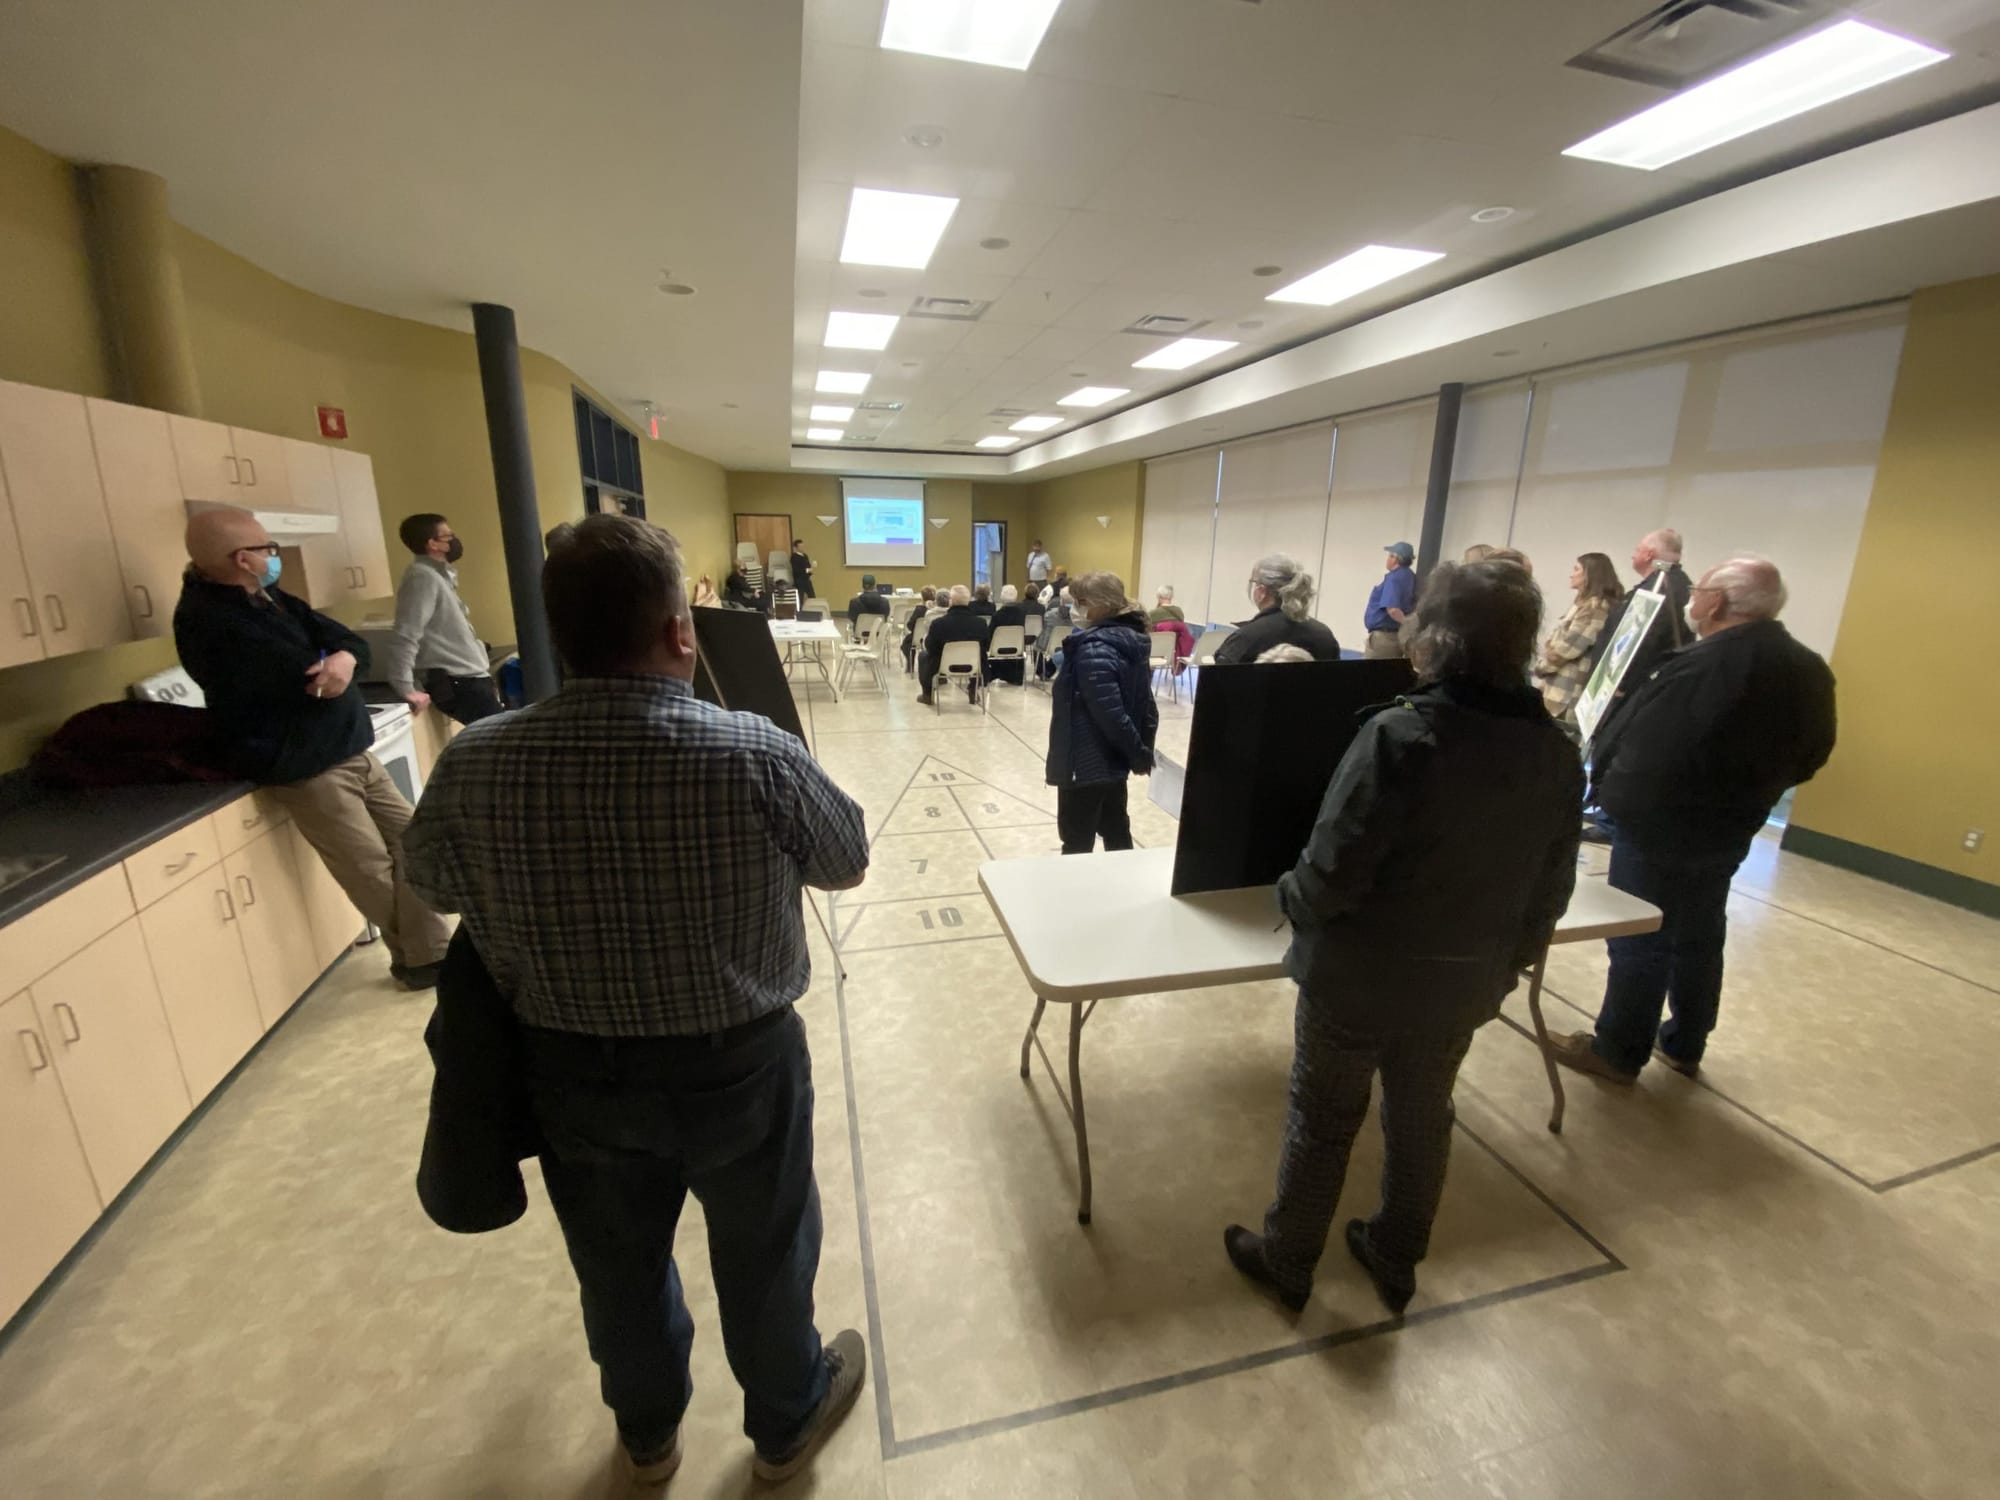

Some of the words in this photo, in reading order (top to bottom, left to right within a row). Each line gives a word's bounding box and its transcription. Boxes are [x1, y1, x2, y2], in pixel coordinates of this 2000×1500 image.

[928, 772, 956, 782] 10
[924, 806, 942, 818] 8
[909, 859, 928, 874] 7
[916, 907, 964, 930] 10
